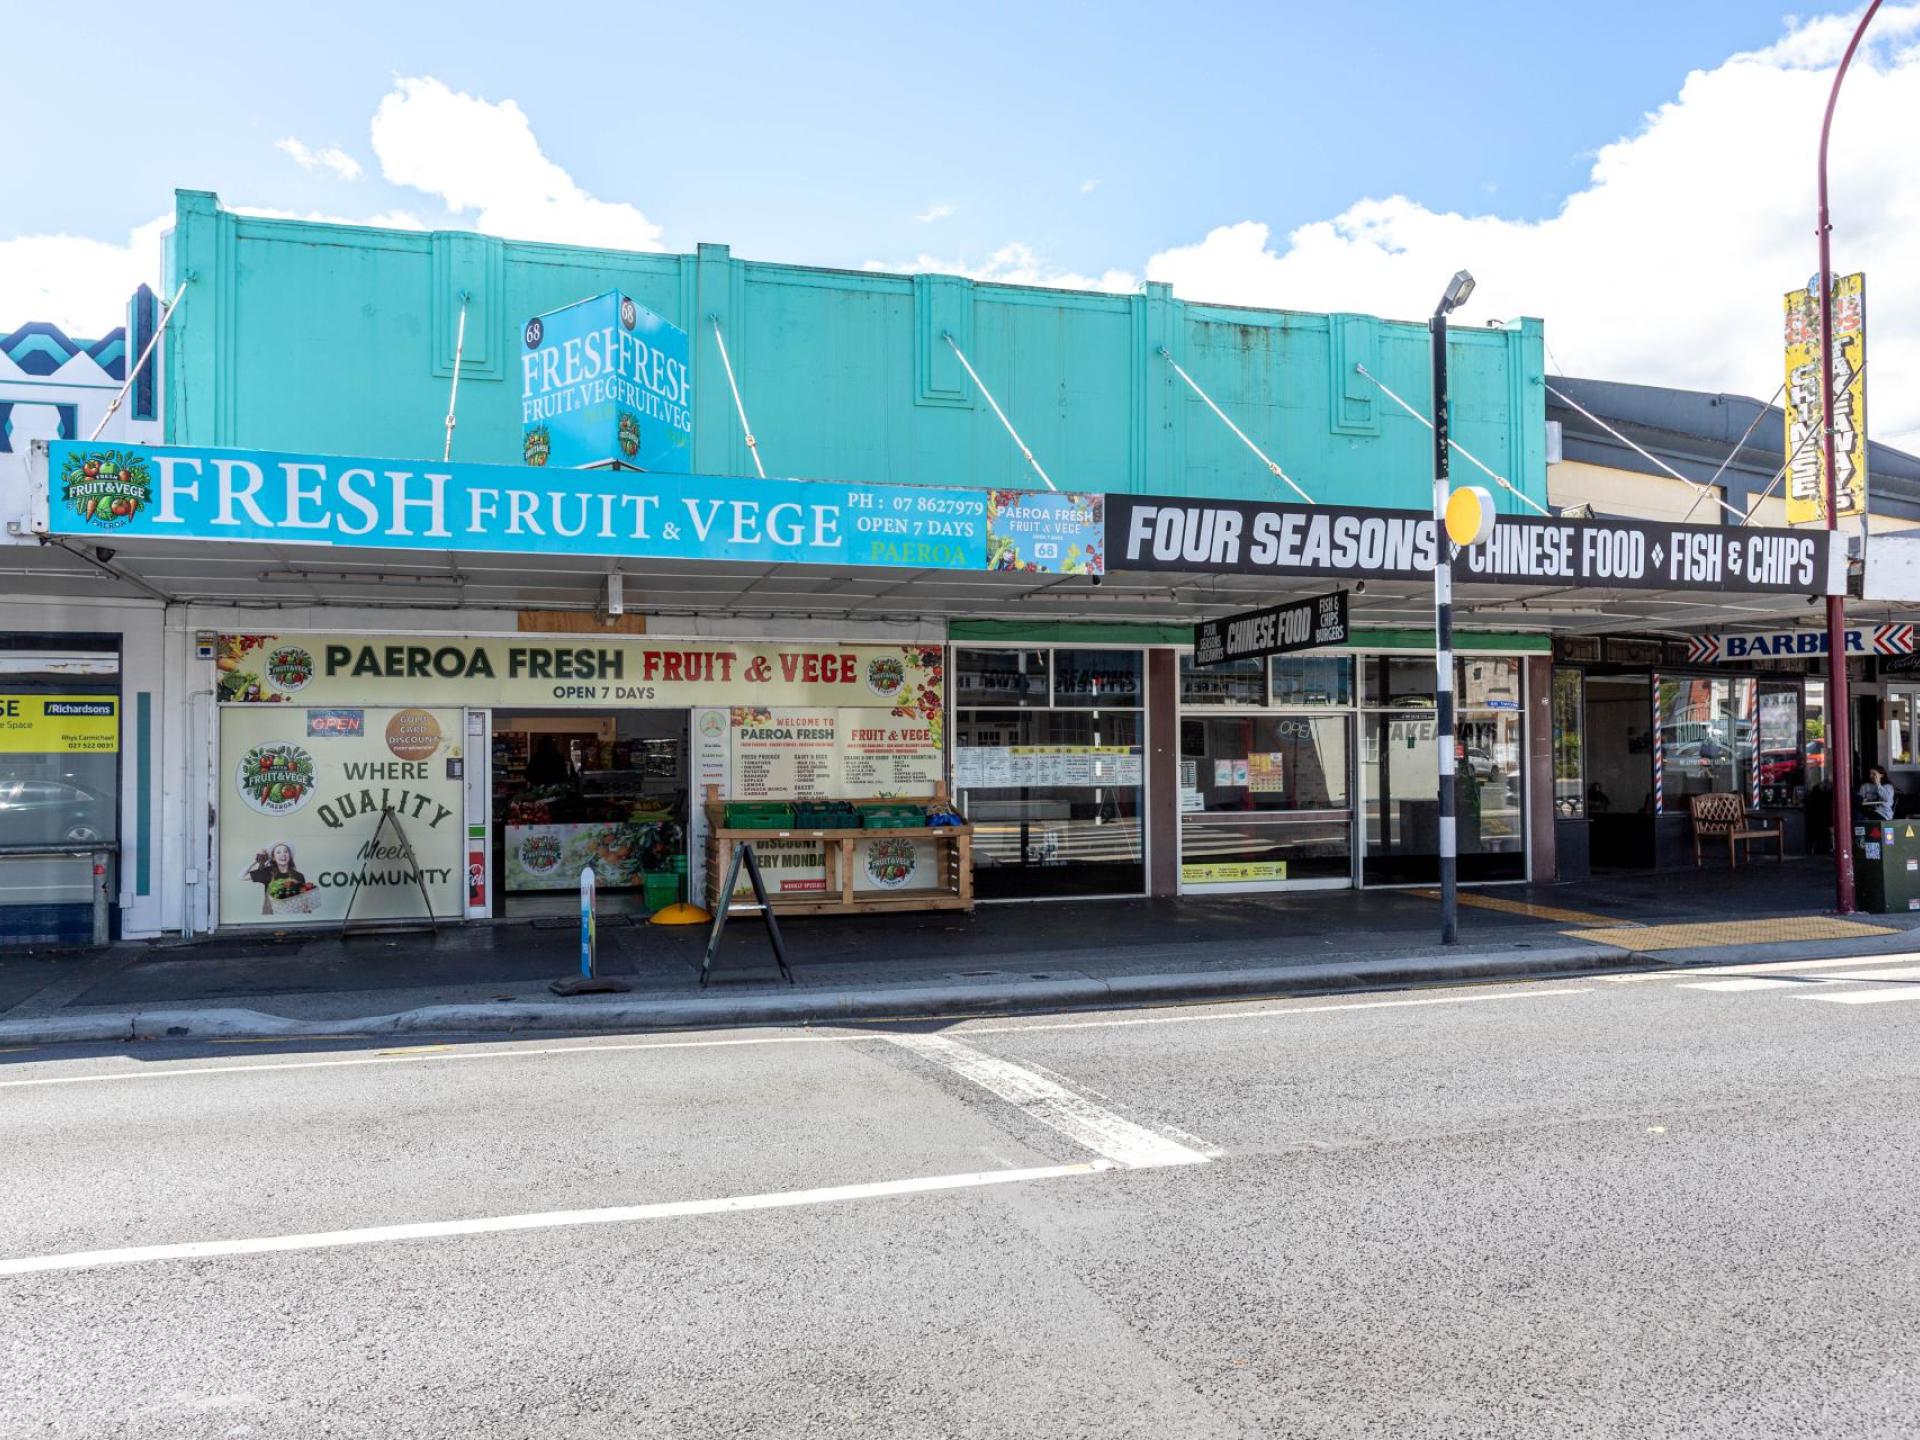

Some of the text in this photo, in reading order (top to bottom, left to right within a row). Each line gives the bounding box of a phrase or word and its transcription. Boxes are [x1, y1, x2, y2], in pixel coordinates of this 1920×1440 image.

[621, 301, 635, 323] 68
[526, 324, 540, 343] 68
[152, 455, 842, 548] FRESH FRUIT & VEGE
[848, 493, 873, 509] PH
[892, 496, 912, 511] 07
[917, 498, 984, 516] 8627979
[997, 505, 1094, 522] PAEROA FRESH
[857, 516, 974, 538] OPEN 7 DAYS
[1009, 520, 1040, 532] FRUIT
[1055, 522, 1081, 534] VEGE
[870, 540, 968, 565] PAEROA
[1038, 545, 1055, 557] 68
[1126, 505, 1815, 586] FOUR SEASONS CHINESE FOOD FISH & CHIPS
[1319, 599, 1333, 614] FISH
[1320, 611, 1339, 628] CHIPS
[1226, 605, 1312, 655] CHINESE FOOD
[1315, 625, 1344, 644] BURGERS
[325, 645, 858, 684] PAEROA FRESH FRUIT & VEGE
[553, 686, 655, 700] OPEN 7 DAYS
[7, 721, 33, 729] Space
[312, 718, 360, 730] OPEN
[776, 718, 835, 727] WELCOME TO
[740, 728, 835, 740] PAEROA FRESH
[851, 728, 931, 741] FRUIT & VEGE
[343, 762, 429, 780] WHERE
[317, 788, 453, 829] QUALITY
[318, 868, 452, 888] COMMUNITY
